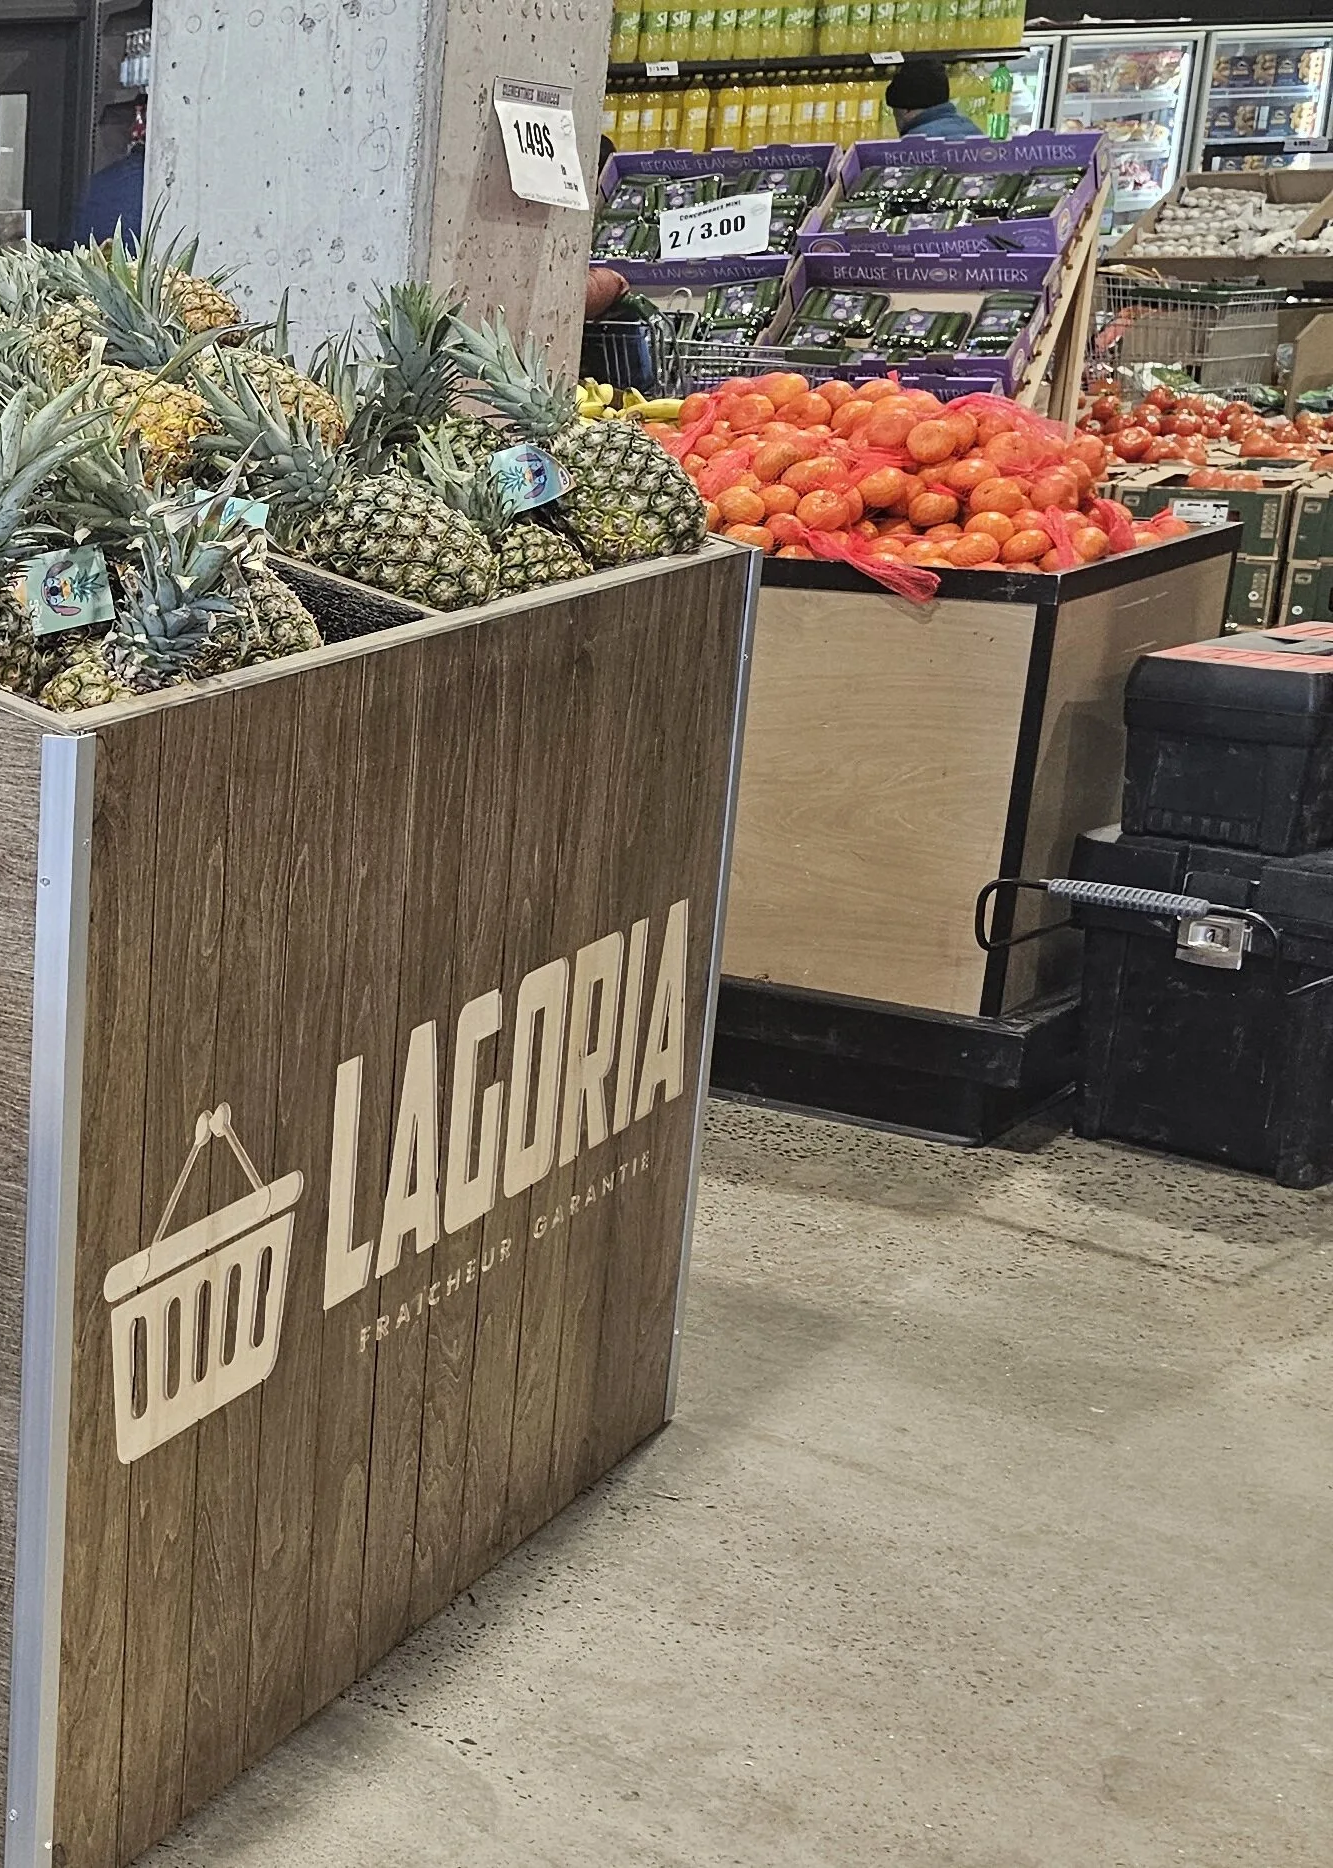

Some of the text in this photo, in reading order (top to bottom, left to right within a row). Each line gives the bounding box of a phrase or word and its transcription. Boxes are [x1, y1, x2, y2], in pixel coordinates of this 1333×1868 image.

[513, 119, 555, 161] 1.49$
[884, 144, 1077, 165] BECAUSE FLAVOR MATTERS
[668, 214, 746, 250] 2 / 3.00
[833, 265, 1029, 283] BECAUSE FLAVOR MATTERS
[323, 898, 690, 1311] LAGORIA
[532, 1149, 652, 1240] GARANTIE
